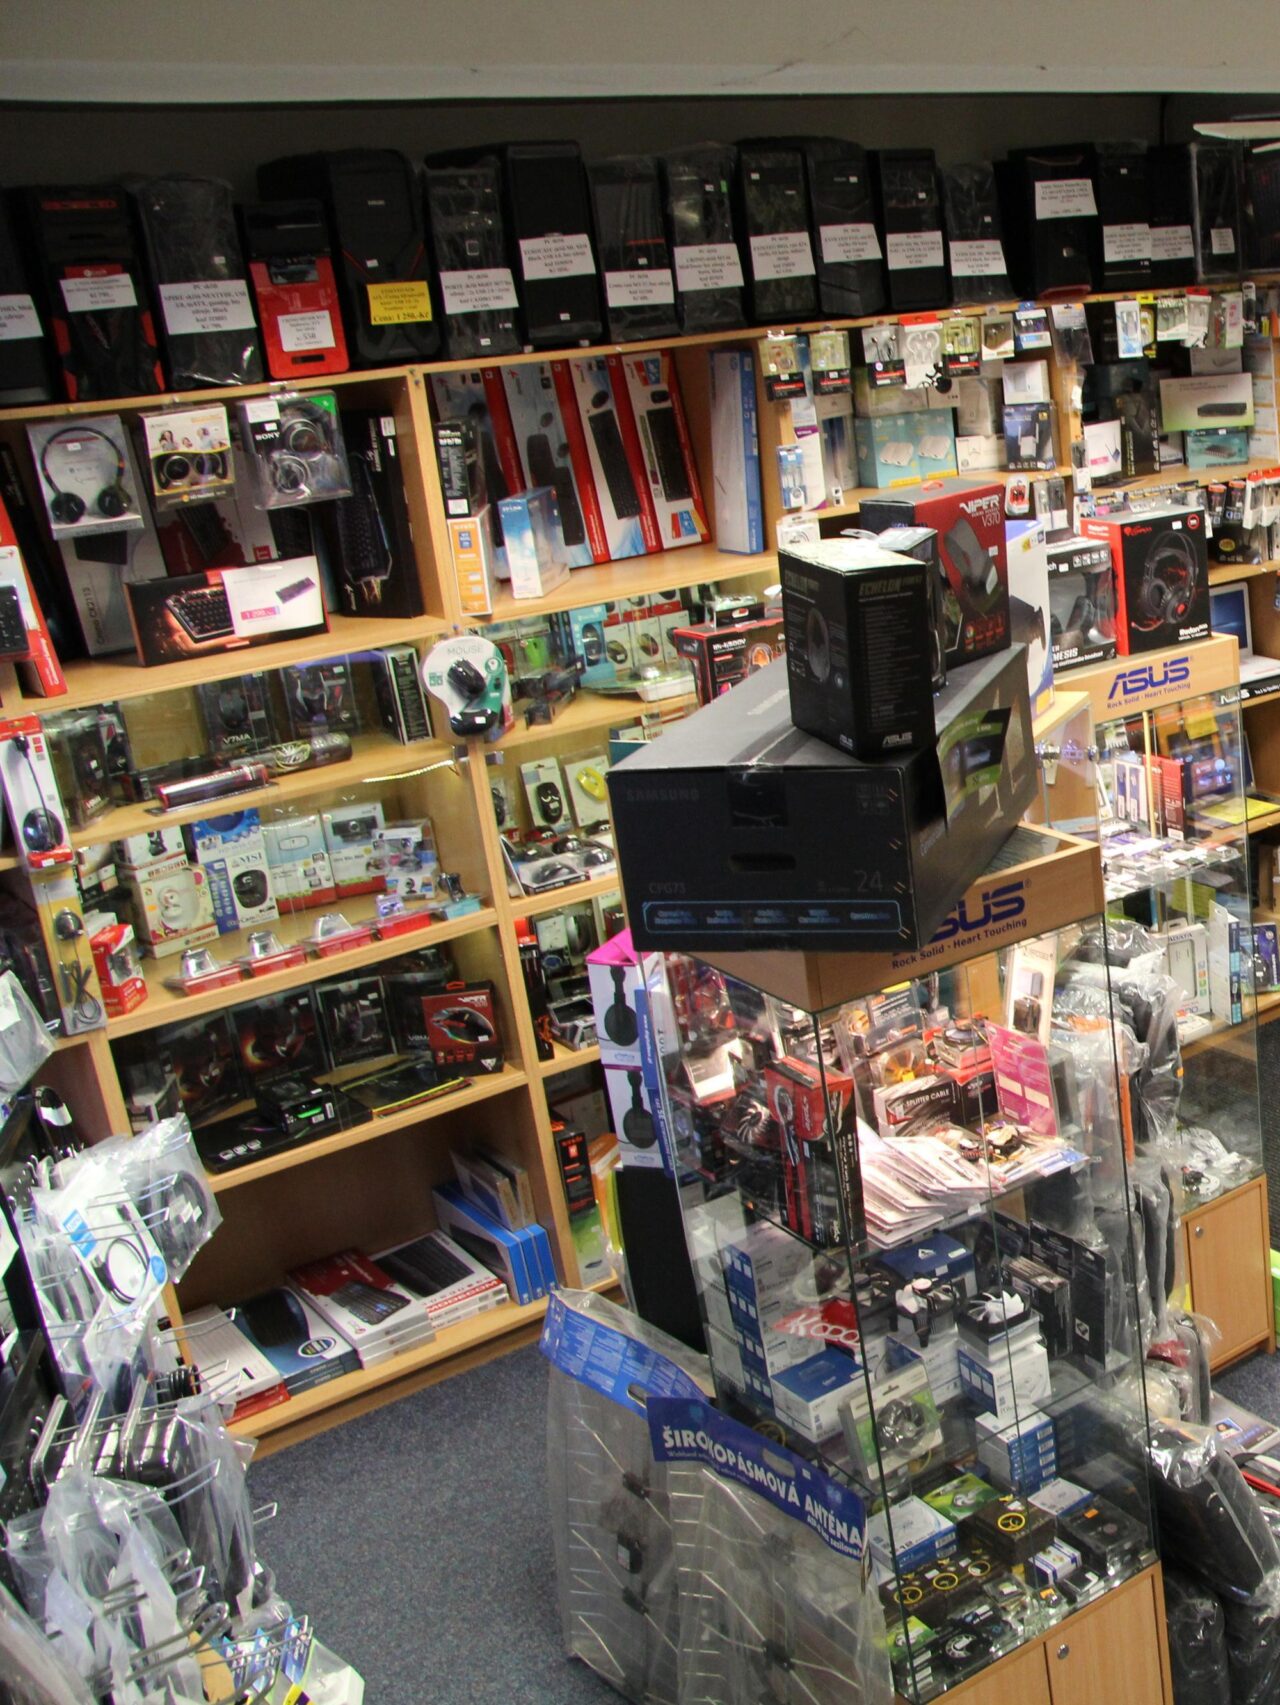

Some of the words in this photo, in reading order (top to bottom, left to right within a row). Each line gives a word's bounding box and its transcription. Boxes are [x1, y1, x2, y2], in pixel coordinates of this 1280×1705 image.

[255, 432, 280, 440] SONY
[959, 494, 1000, 514] VIPER
[447, 645, 482, 655] MOUSE
[1108, 656, 1190, 699] ASUS
[1144, 690, 1162, 699] Heart
[1164, 682, 1191, 696] Touching
[883, 732, 913, 748] ASUS
[626, 787, 700, 802] SAMSUNG
[928, 879, 1026, 945] SUS
[892, 954, 917, 970] Rock
[919, 944, 945, 962] Solid
[953, 933, 982, 950] Heart
[984, 917, 1028, 939] Touching
[931, 1088, 950, 1100] CABLE
[661, 1426, 801, 1507] ŠIROKOPÁSMOVÁ
[804, 1493, 864, 1546] ANTÉNA
